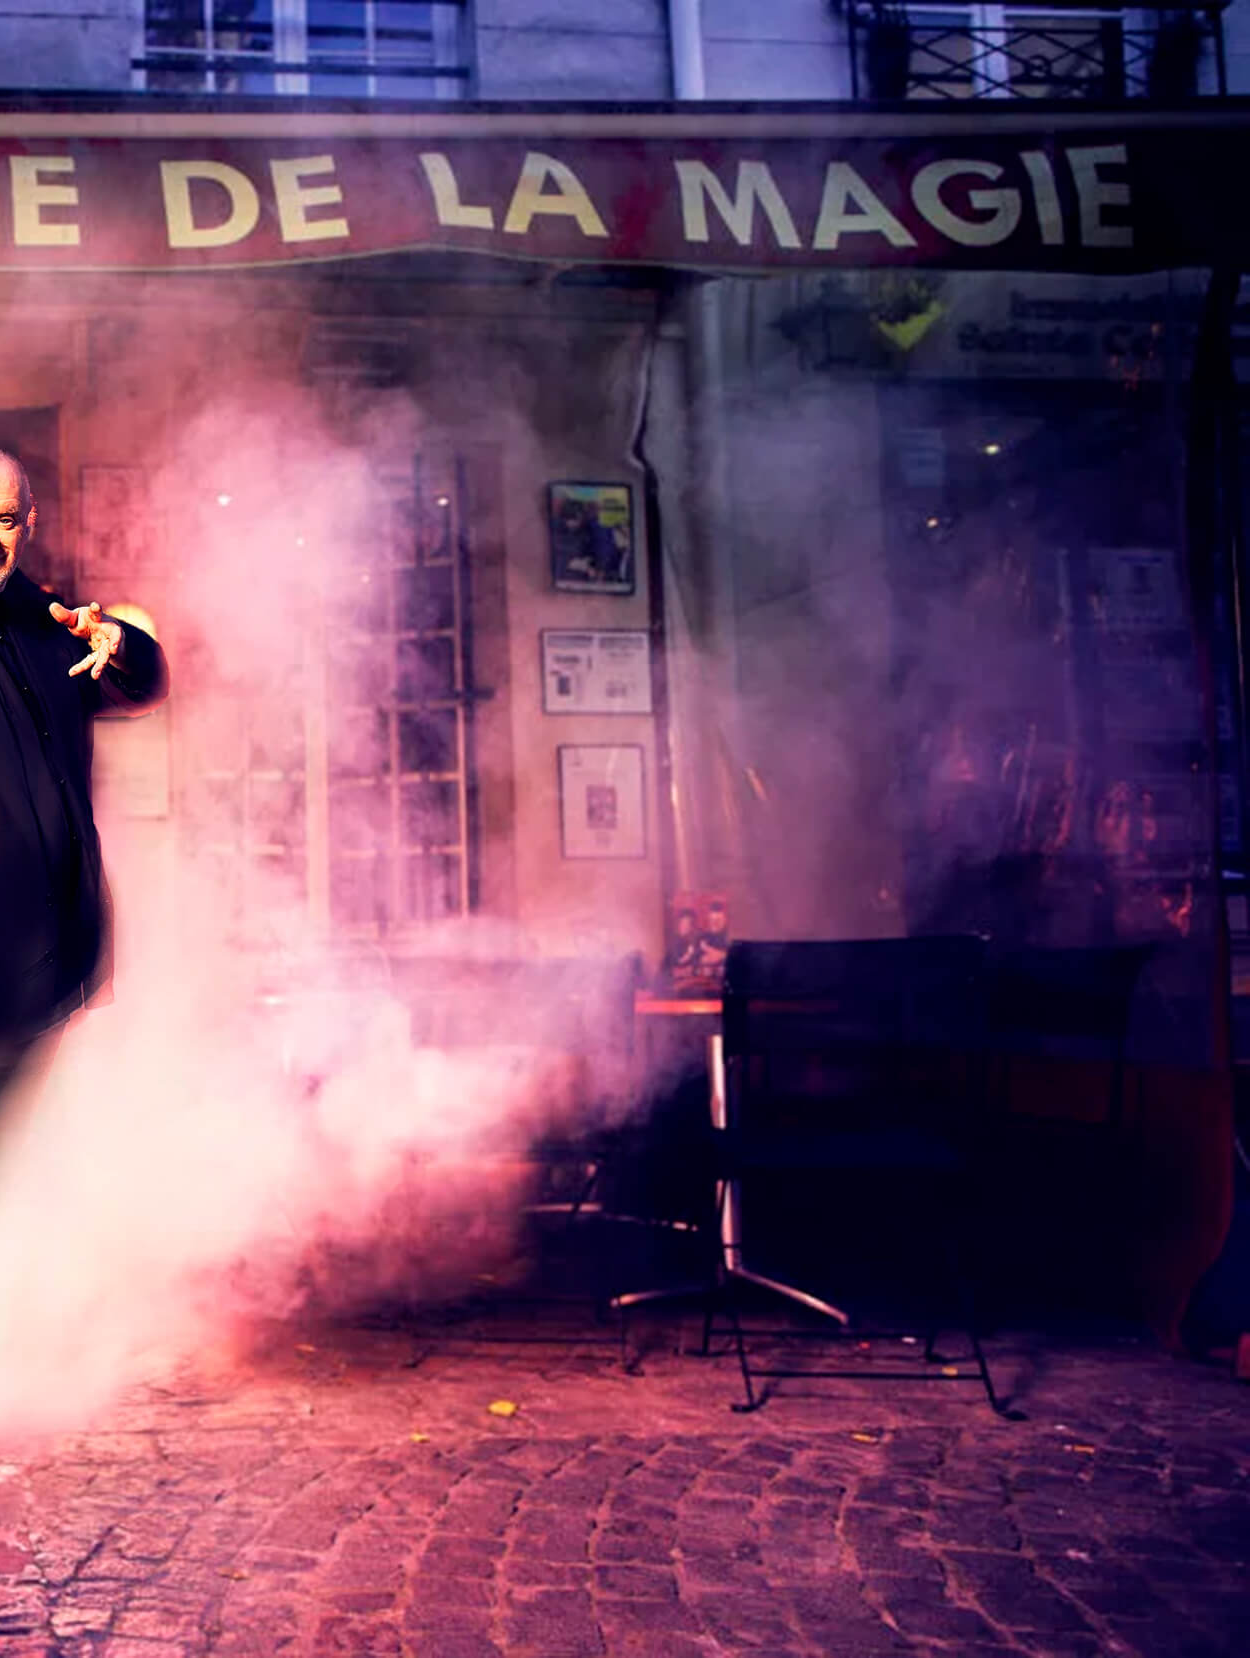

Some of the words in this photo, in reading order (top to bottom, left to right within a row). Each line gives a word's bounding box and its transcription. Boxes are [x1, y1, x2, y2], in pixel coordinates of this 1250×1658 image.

[159, 155, 350, 249] DE
[419, 151, 611, 238] LA
[674, 144, 1135, 251] MAGIE
